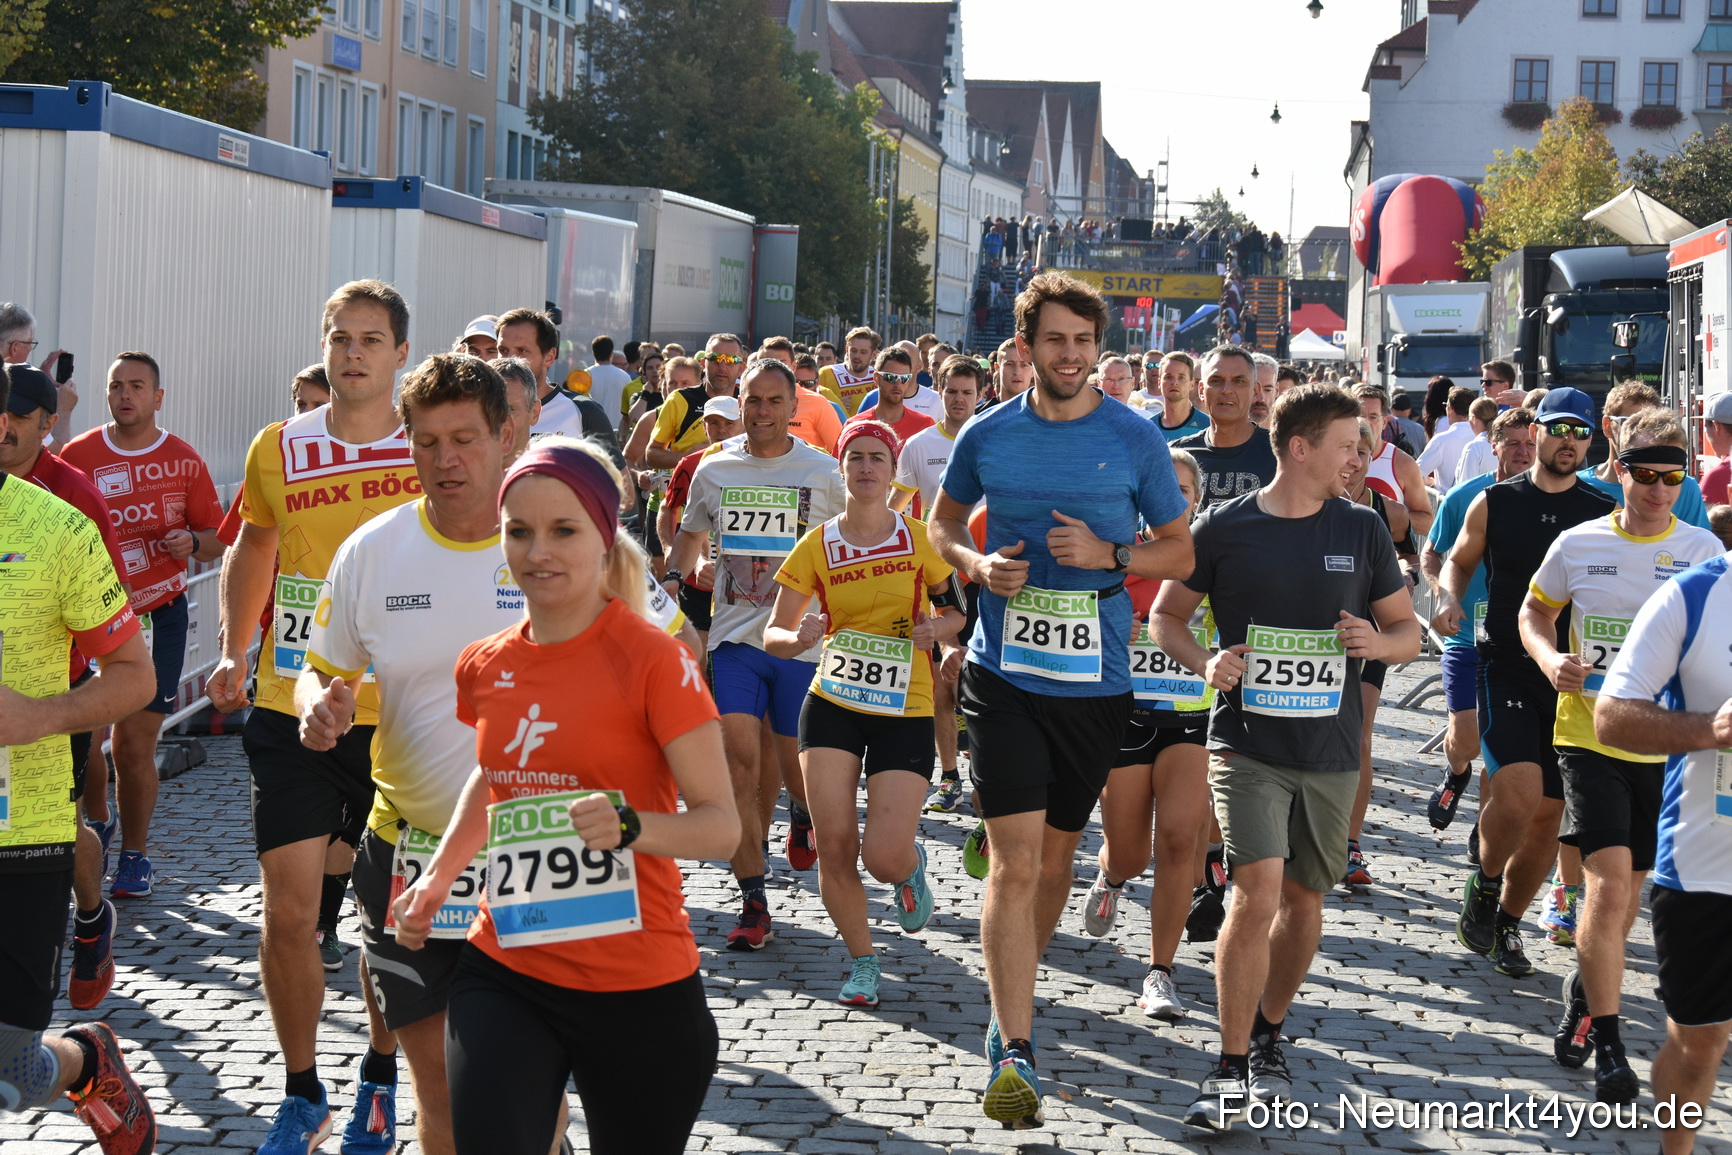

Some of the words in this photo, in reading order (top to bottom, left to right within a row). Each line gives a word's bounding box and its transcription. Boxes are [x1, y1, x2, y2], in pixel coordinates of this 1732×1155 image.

[719, 258, 745, 308] BOCK
[765, 283, 794, 302] BO
[1103, 275, 1164, 292] START
[1415, 309, 1461, 317] BOCK
[840, 388, 863, 398] MAX
[97, 464, 128, 476] raumbox
[138, 481, 177, 492] schenken
[285, 483, 352, 514] MAX
[725, 489, 792, 507] BOCK
[129, 523, 160, 535] outdoor
[727, 511, 786, 533] 2771
[1656, 553, 1673, 566] 20
[829, 569, 867, 586] MAX
[872, 561, 916, 577] BÖGL
[282, 580, 327, 606] BO
[386, 594, 432, 608] BOCK
[1013, 590, 1091, 616] BOCK
[1014, 616, 1091, 650] 2818
[1590, 619, 1633, 640] BO
[833, 633, 906, 660] BOCK
[1254, 630, 1338, 653] BOCK
[830, 655, 898, 688] 2381
[1022, 650, 1068, 674] Philipp
[1255, 658, 1334, 687] 2594
[1144, 679, 1195, 694] LAURA
[1255, 692, 1329, 707] GÜNTHER
[485, 767, 579, 787] funrunners
[494, 800, 571, 842] BOC
[497, 846, 614, 896] 2799
